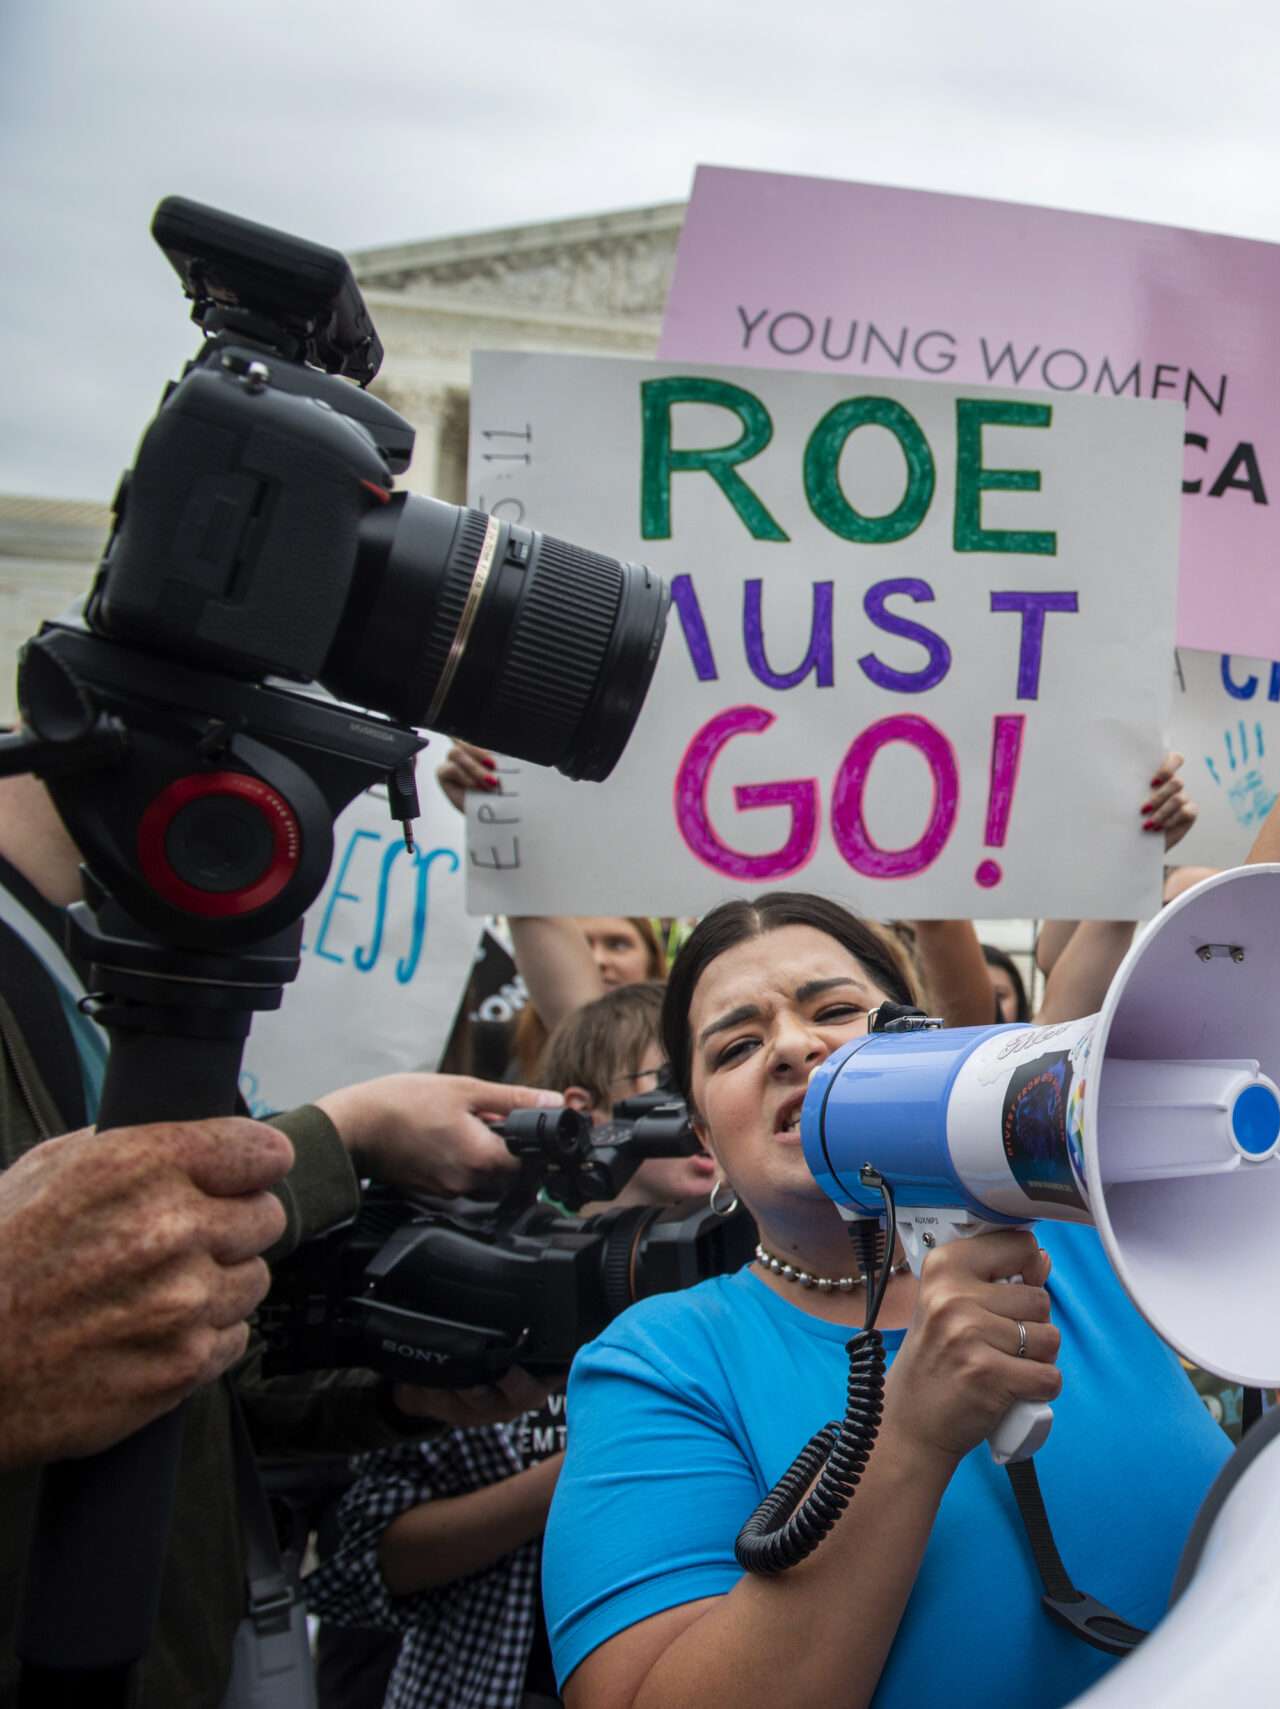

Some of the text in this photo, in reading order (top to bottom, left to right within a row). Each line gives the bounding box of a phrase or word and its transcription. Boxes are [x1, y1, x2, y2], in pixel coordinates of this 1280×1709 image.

[736, 305, 1228, 417] YOUNG WOMEN
[641, 376, 1058, 556] ROE
[673, 704, 1026, 890] GO!
[313, 828, 461, 985] ESS
[381, 1338, 449, 1366] SONY
